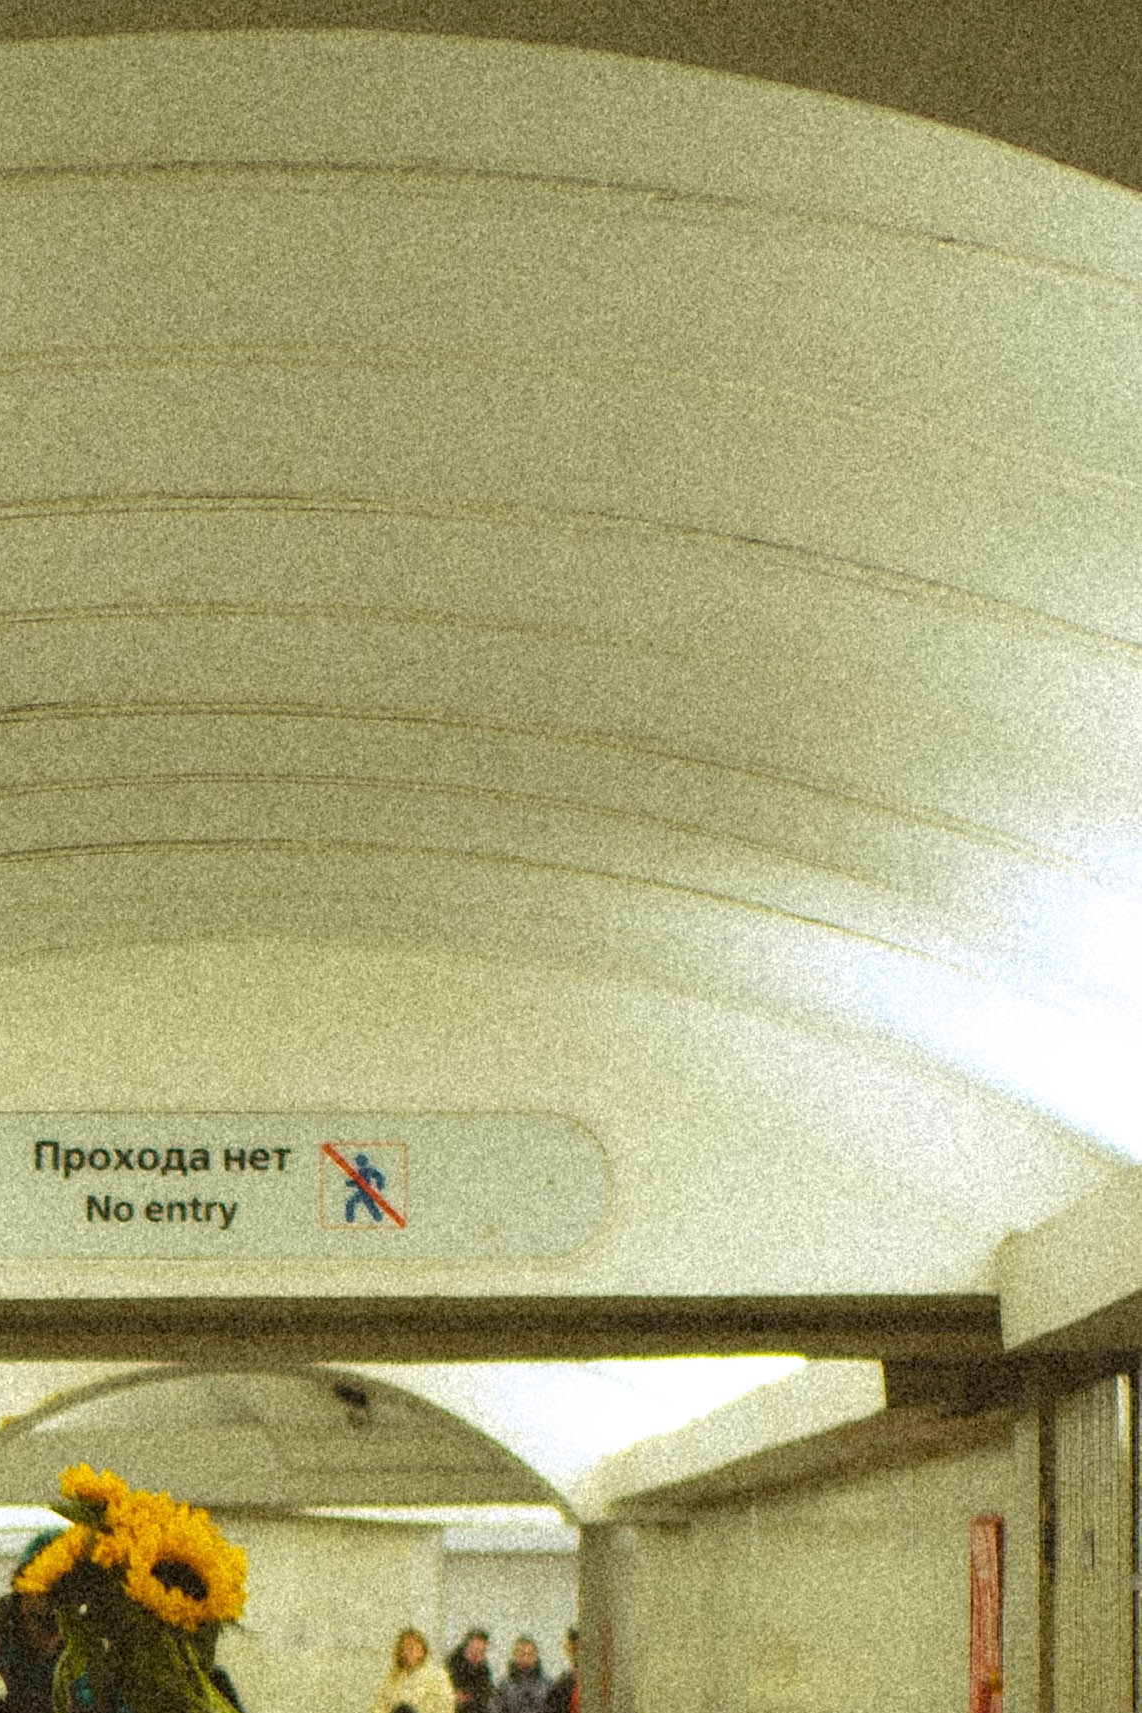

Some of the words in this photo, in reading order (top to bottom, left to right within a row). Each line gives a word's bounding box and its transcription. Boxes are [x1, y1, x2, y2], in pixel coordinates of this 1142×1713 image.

[34, 1140, 210, 1179] Прохода
[223, 1147, 292, 1172] нет
[86, 1195, 135, 1223] No
[143, 1197, 238, 1231] entry
